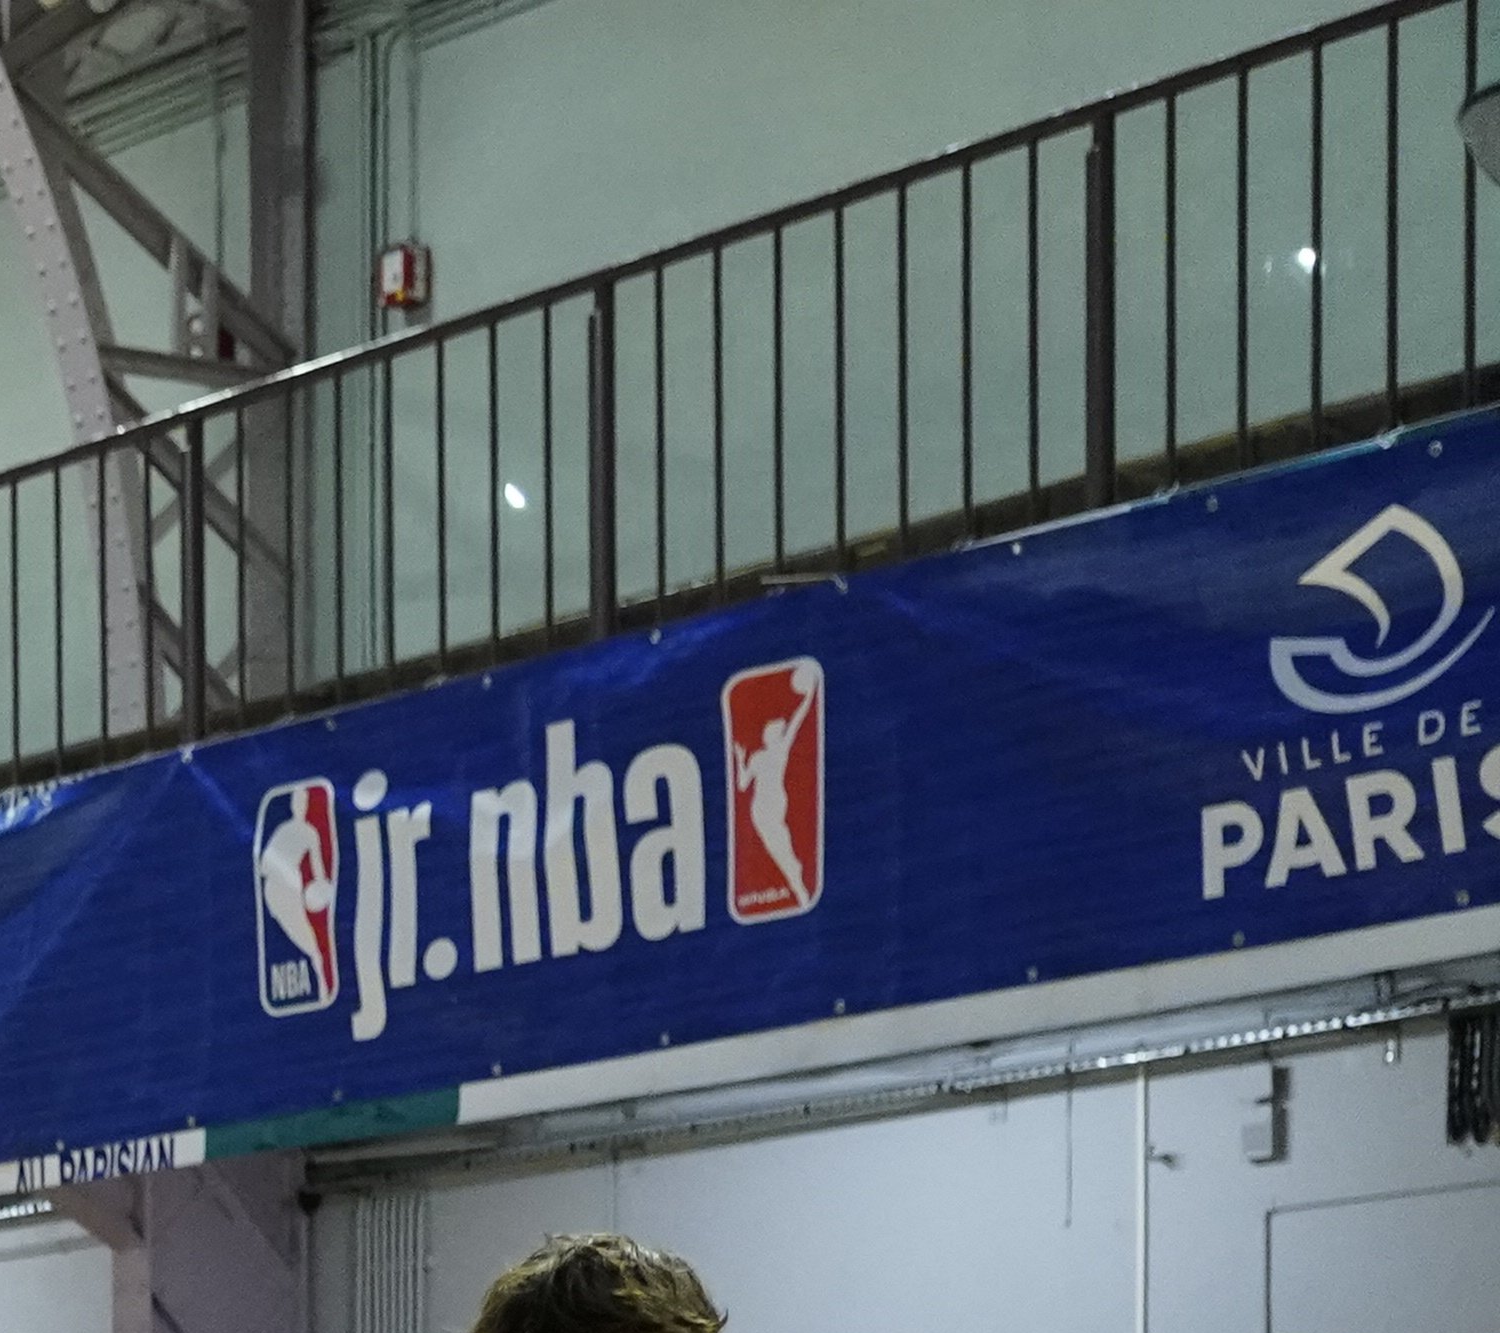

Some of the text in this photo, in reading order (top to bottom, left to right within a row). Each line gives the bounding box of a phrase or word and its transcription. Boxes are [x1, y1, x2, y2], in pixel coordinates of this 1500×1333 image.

[1242, 700, 1482, 781] VILLE DE
[271, 960, 311, 999] NBA
